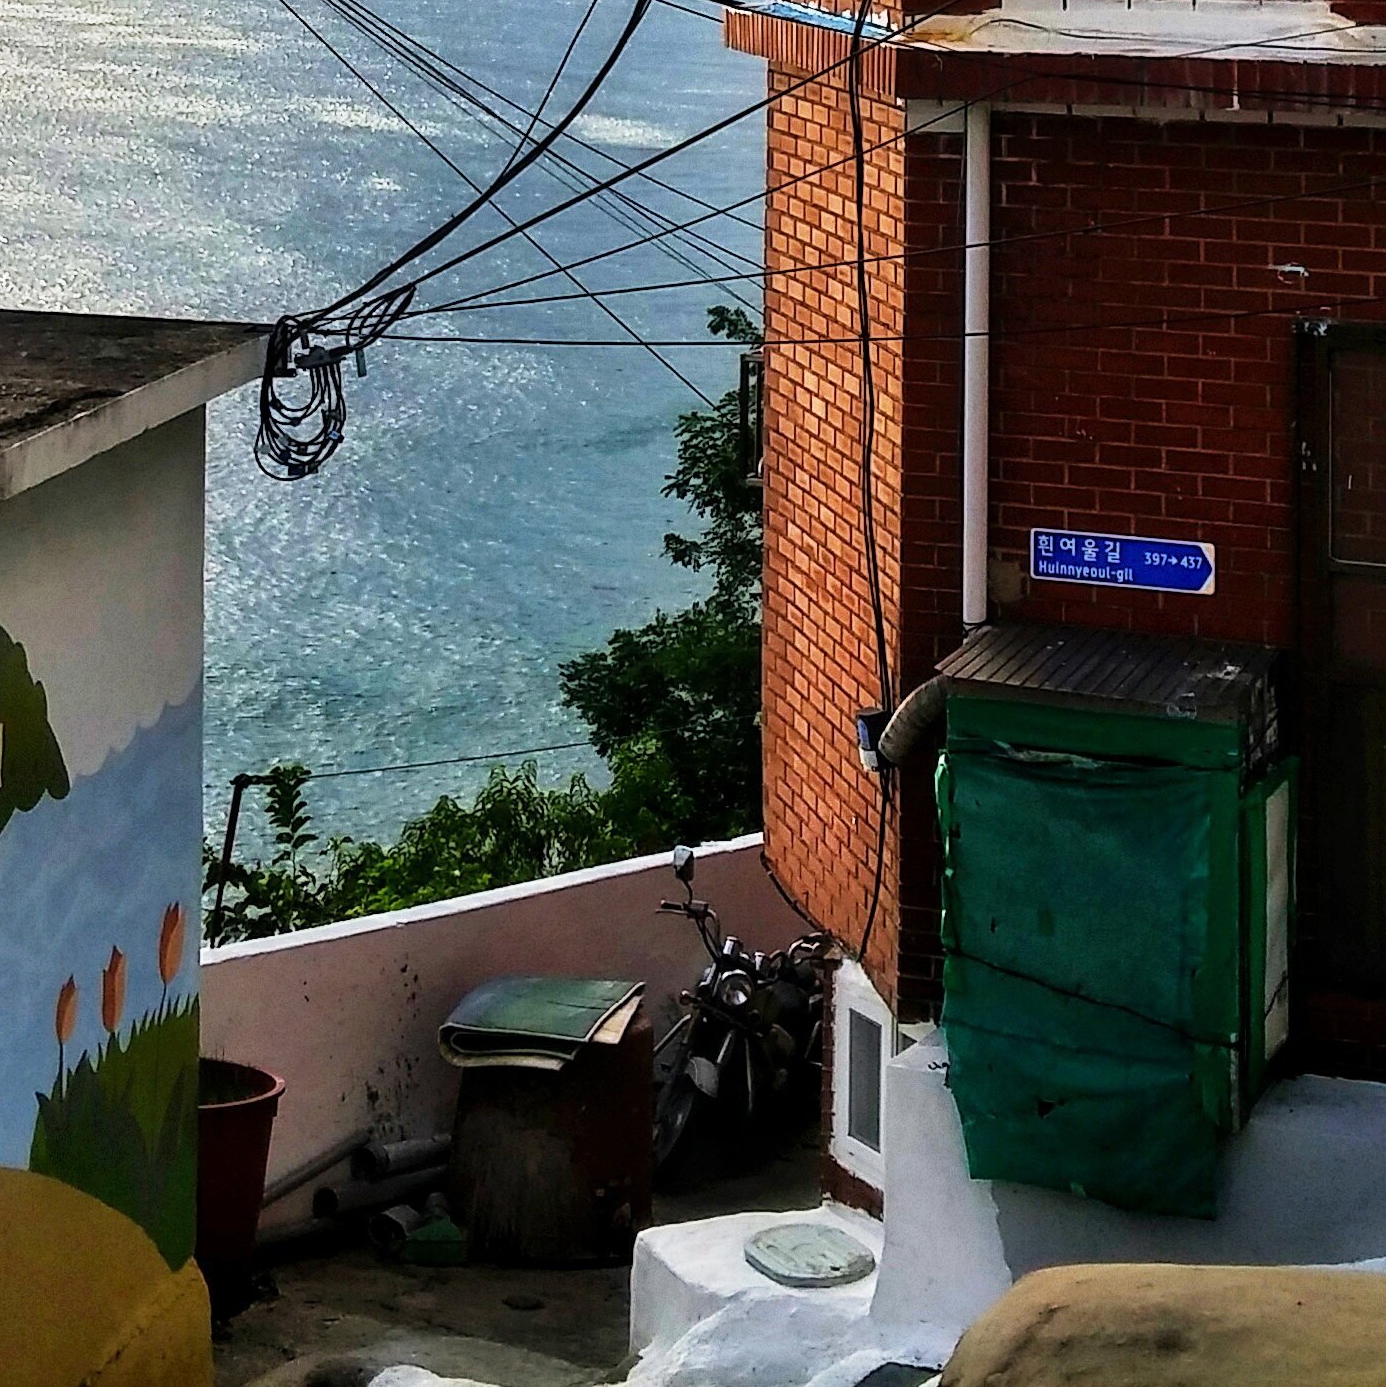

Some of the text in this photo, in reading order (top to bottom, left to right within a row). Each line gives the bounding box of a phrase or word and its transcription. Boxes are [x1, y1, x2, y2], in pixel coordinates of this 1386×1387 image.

[1038, 559, 1133, 582] Huinnyeoul-gil
[1144, 551, 1203, 570] 397 437
